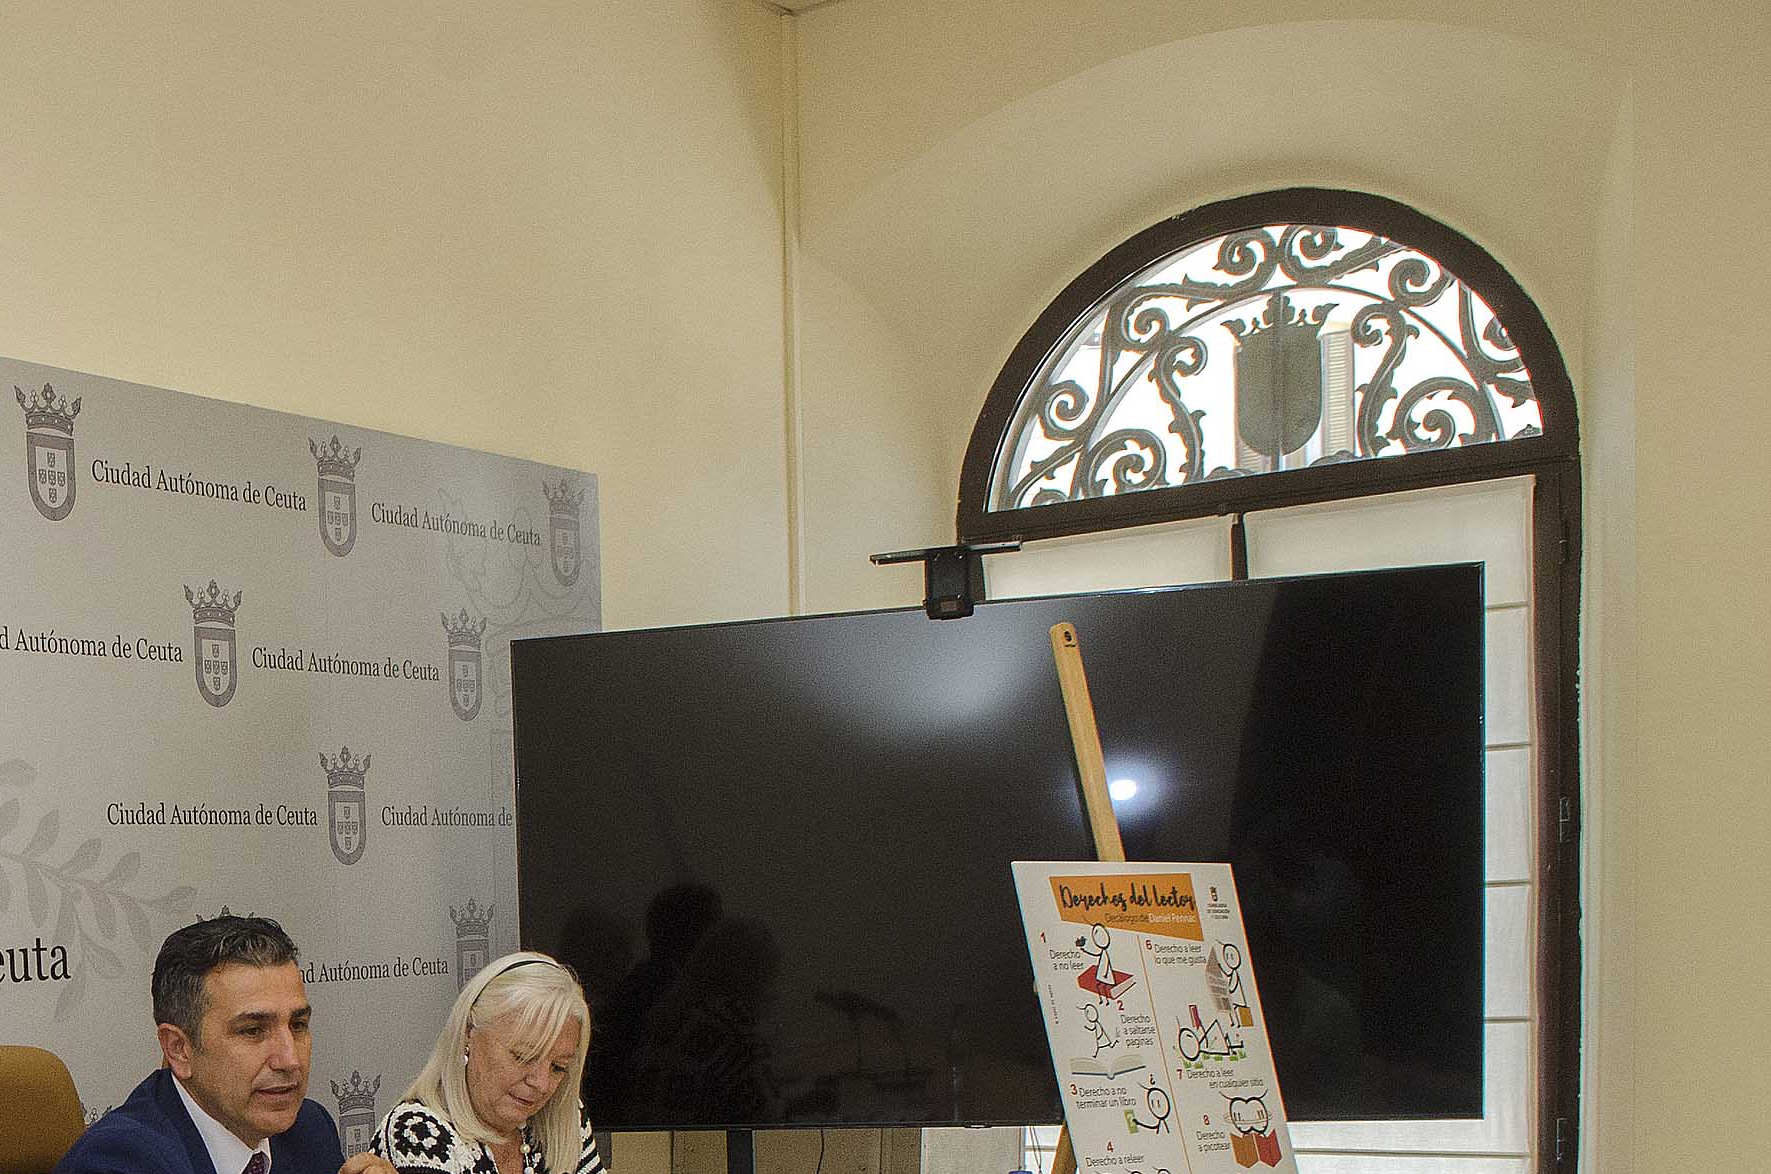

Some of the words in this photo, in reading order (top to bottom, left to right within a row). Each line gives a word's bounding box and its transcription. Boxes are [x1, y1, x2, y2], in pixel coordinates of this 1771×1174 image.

[91, 459, 152, 489] Ciudad
[156, 469, 239, 502] Autónoma
[242, 481, 261, 504] de
[265, 485, 307, 512] Ceuta
[371, 502, 418, 529] Ciudad
[422, 511, 487, 538] Autónoma
[490, 520, 505, 541] de
[507, 523, 542, 546] Ceuta
[15, 628, 108, 657] Autónoma
[112, 634, 132, 659] de
[136, 637, 184, 663] Ceuta
[252, 646, 304, 672] Ciudad
[307, 652, 380, 677] Autónoma
[384, 657, 400, 679] de
[403, 659, 440, 682] Ceuta
[107, 802, 166, 826] Ciudad
[170, 803, 252, 826] Autónoma
[255, 803, 273, 826] de
[277, 804, 318, 826] Ceuta
[381, 804, 428, 827] Ciudad
[431, 805, 496, 827] Autónoma
[498, 806, 513, 827] de
[1039, 932, 1046, 943] 1
[1146, 940, 1153, 950] 6
[1049, 949, 1081, 960] Derecho
[319, 959, 390, 983] Autónoma
[393, 957, 409, 977] de
[412, 955, 449, 977] Ceuta
[1116, 1000, 1125, 1011] 2
[1176, 1069, 1183, 1080] 7
[1070, 1084, 1078, 1095] 3
[1203, 1114, 1210, 1125] 8
[1107, 1141, 1114, 1152] 4
